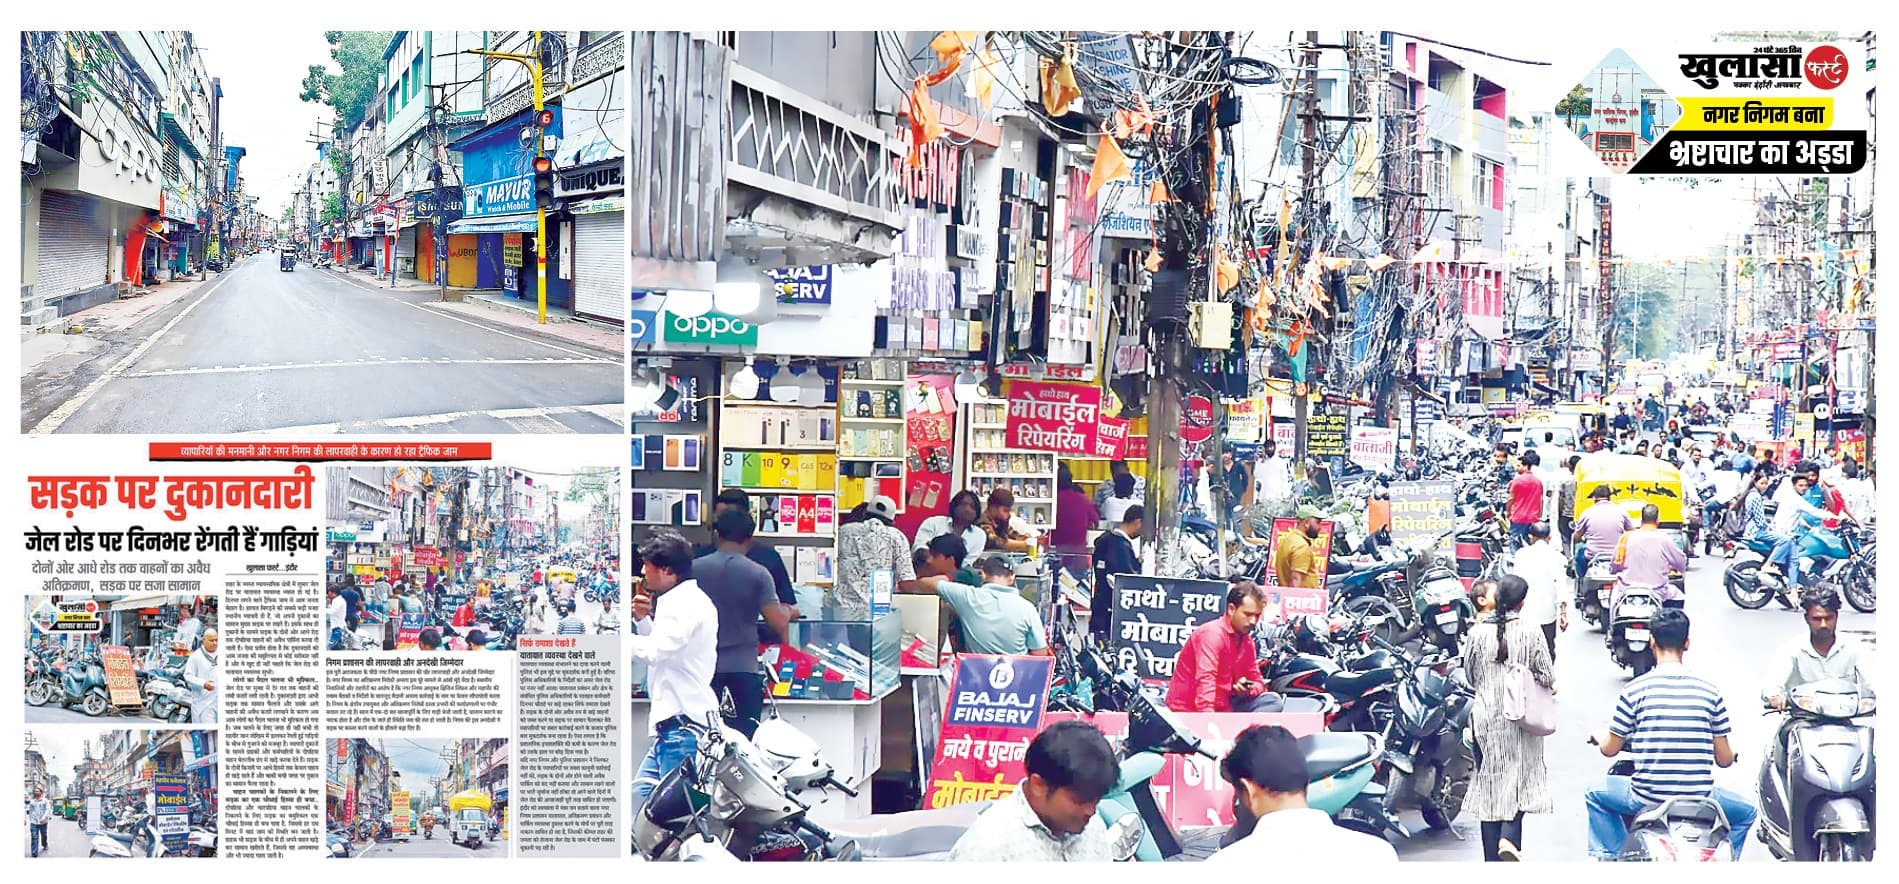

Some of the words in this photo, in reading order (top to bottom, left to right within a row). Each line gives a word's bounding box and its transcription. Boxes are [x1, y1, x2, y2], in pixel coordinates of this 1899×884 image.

[561, 168, 620, 192] UNIQUE
[485, 179, 531, 205] MAYUR
[506, 201, 530, 211] Mobile
[764, 264, 828, 281] AJAJ
[674, 317, 749, 338] oppo
[1011, 392, 1097, 426] मोबाईल
[1017, 422, 1087, 450] रिपेयरिंग
[181, 445, 213, 455] व्यापारियों
[216, 445, 225, 455] की
[228, 445, 254, 455] मनमानी
[257, 445, 271, 456] और
[274, 447, 289, 456] नगर
[292, 445, 310, 456] निगम
[313, 445, 323, 455] की
[325, 445, 358, 456] लापरवाही
[360, 447, 368, 455] के
[371, 447, 391, 456] कारण
[418, 445, 440, 457] ट्रैफिक
[443, 448, 457, 456] जाम
[723, 453, 733, 466] 8
[742, 454, 752, 467] K
[762, 458, 774, 468] 10
[781, 457, 791, 469] 9
[28, 476, 110, 518] सड़क
[114, 476, 159, 509] पर
[164, 465, 315, 521] दुकानदारी
[798, 507, 815, 519] A4
[24, 526, 61, 551] जेल
[64, 526, 95, 551] रोड
[98, 532, 123, 551] पर
[126, 526, 191, 551] दिनभर
[194, 525, 240, 551] रेंगती
[242, 525, 260, 551] हैं
[260, 531, 319, 557] गाड़ियां
[32, 560, 54, 574] दोनों
[56, 560, 75, 574] ओर
[77, 560, 97, 574] आधे
[100, 560, 117, 574] रोड
[119, 564, 137, 574] तक
[139, 560, 169, 574] वाहनों
[170, 564, 184, 573] का
[187, 559, 211, 574] अवैध
[42, 578, 93, 592] अतिक्रमण,
[99, 581, 126, 592] सड़क
[128, 581, 142, 591] पर
[144, 581, 165, 591] सजा
[168, 581, 201, 591] सामान
[1120, 583, 1167, 610] हाथो
[1182, 593, 1222, 613] हाथ
[1120, 613, 1197, 645] मोबाई
[325, 657, 342, 667] निगम
[365, 656, 374, 667] की
[375, 656, 402, 667] लापरवाही
[402, 657, 415, 667] और
[957, 691, 1037, 708] BAJAJ
[953, 707, 1034, 725] FINSERV
[943, 734, 973, 760] नये
[973, 739, 987, 760] व
[985, 737, 1030, 769] पुराने
